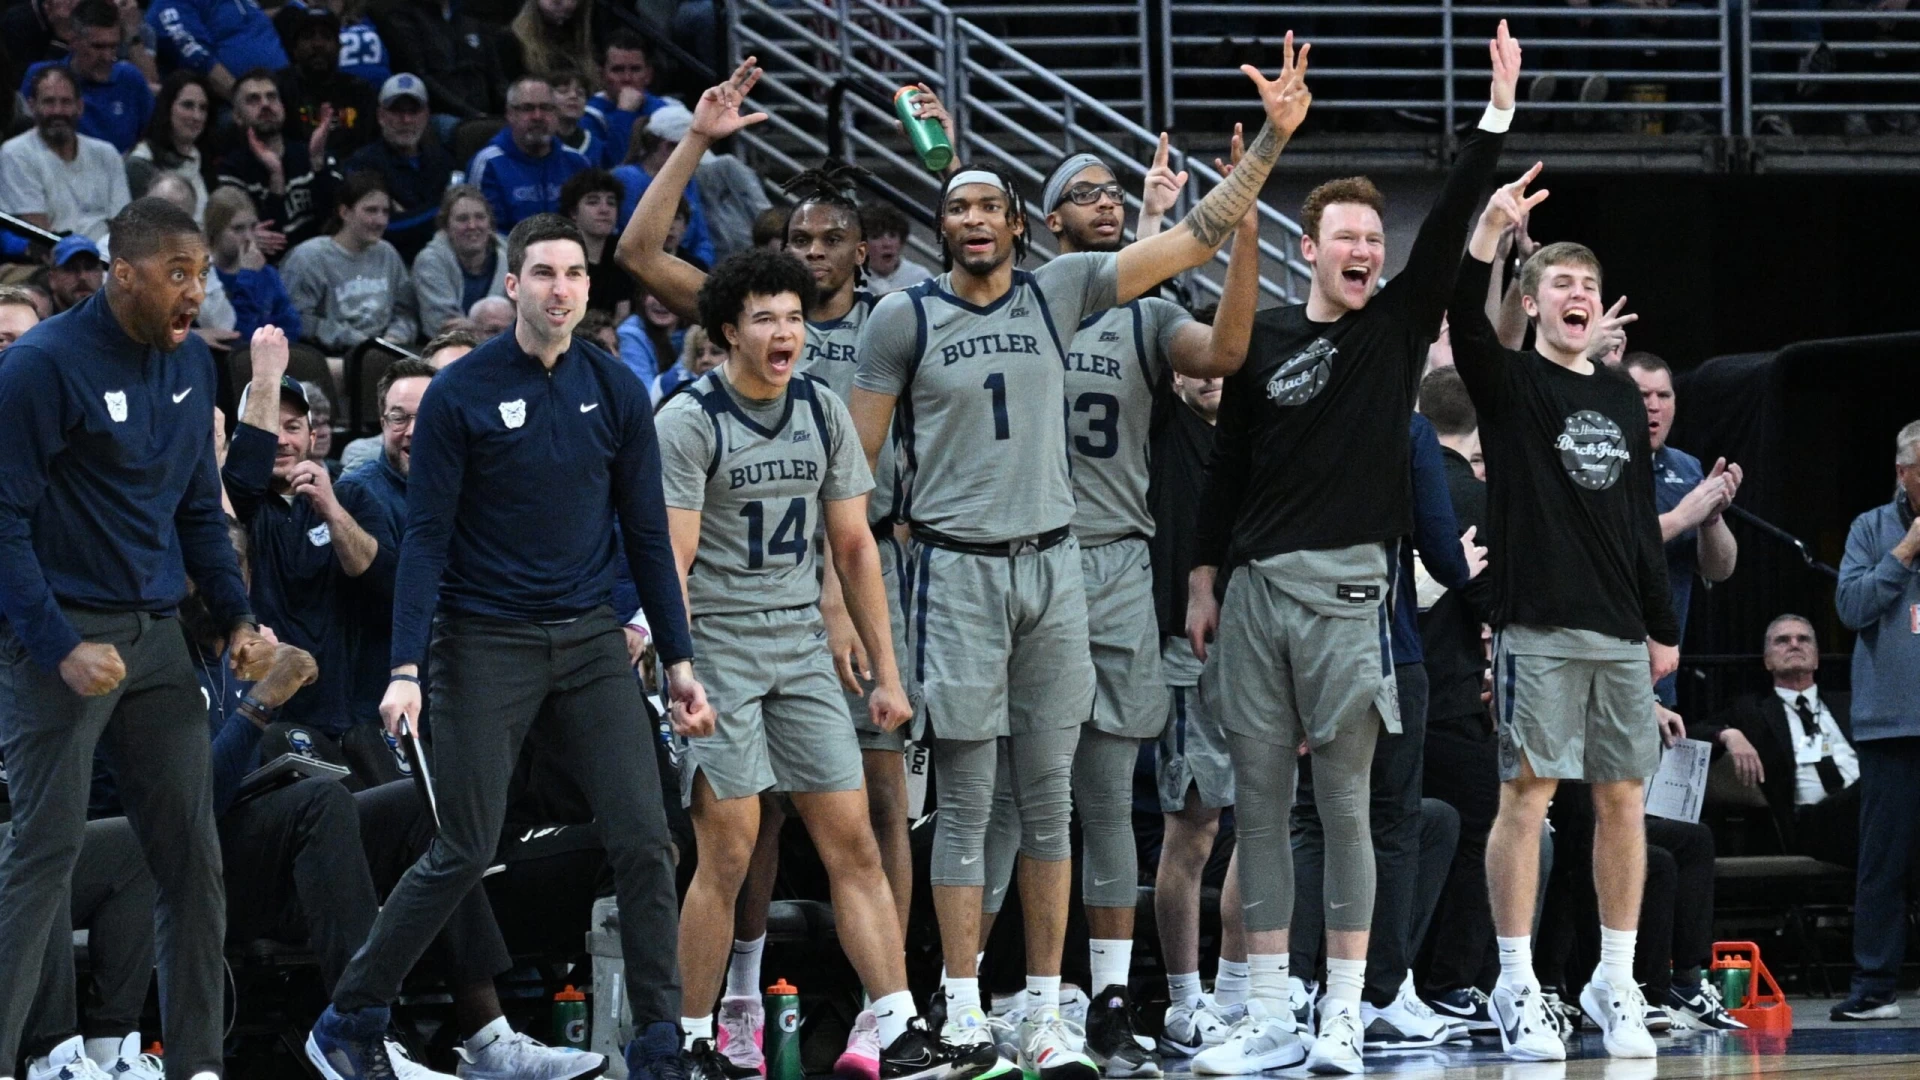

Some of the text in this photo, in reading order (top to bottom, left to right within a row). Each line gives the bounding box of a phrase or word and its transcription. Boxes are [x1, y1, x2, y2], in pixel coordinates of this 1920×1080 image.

[339, 32, 380, 66] 23
[941, 334, 1040, 366] BUTLER
[1065, 353, 1122, 380] TLER
[1266, 370, 1313, 399] Black
[983, 373, 1010, 441] 1
[1064, 392, 1119, 459] 3
[729, 459, 819, 490] BUTLER
[739, 497, 808, 569] 14
[565, 1019, 585, 1043] G
[778, 1008, 797, 1033] G
